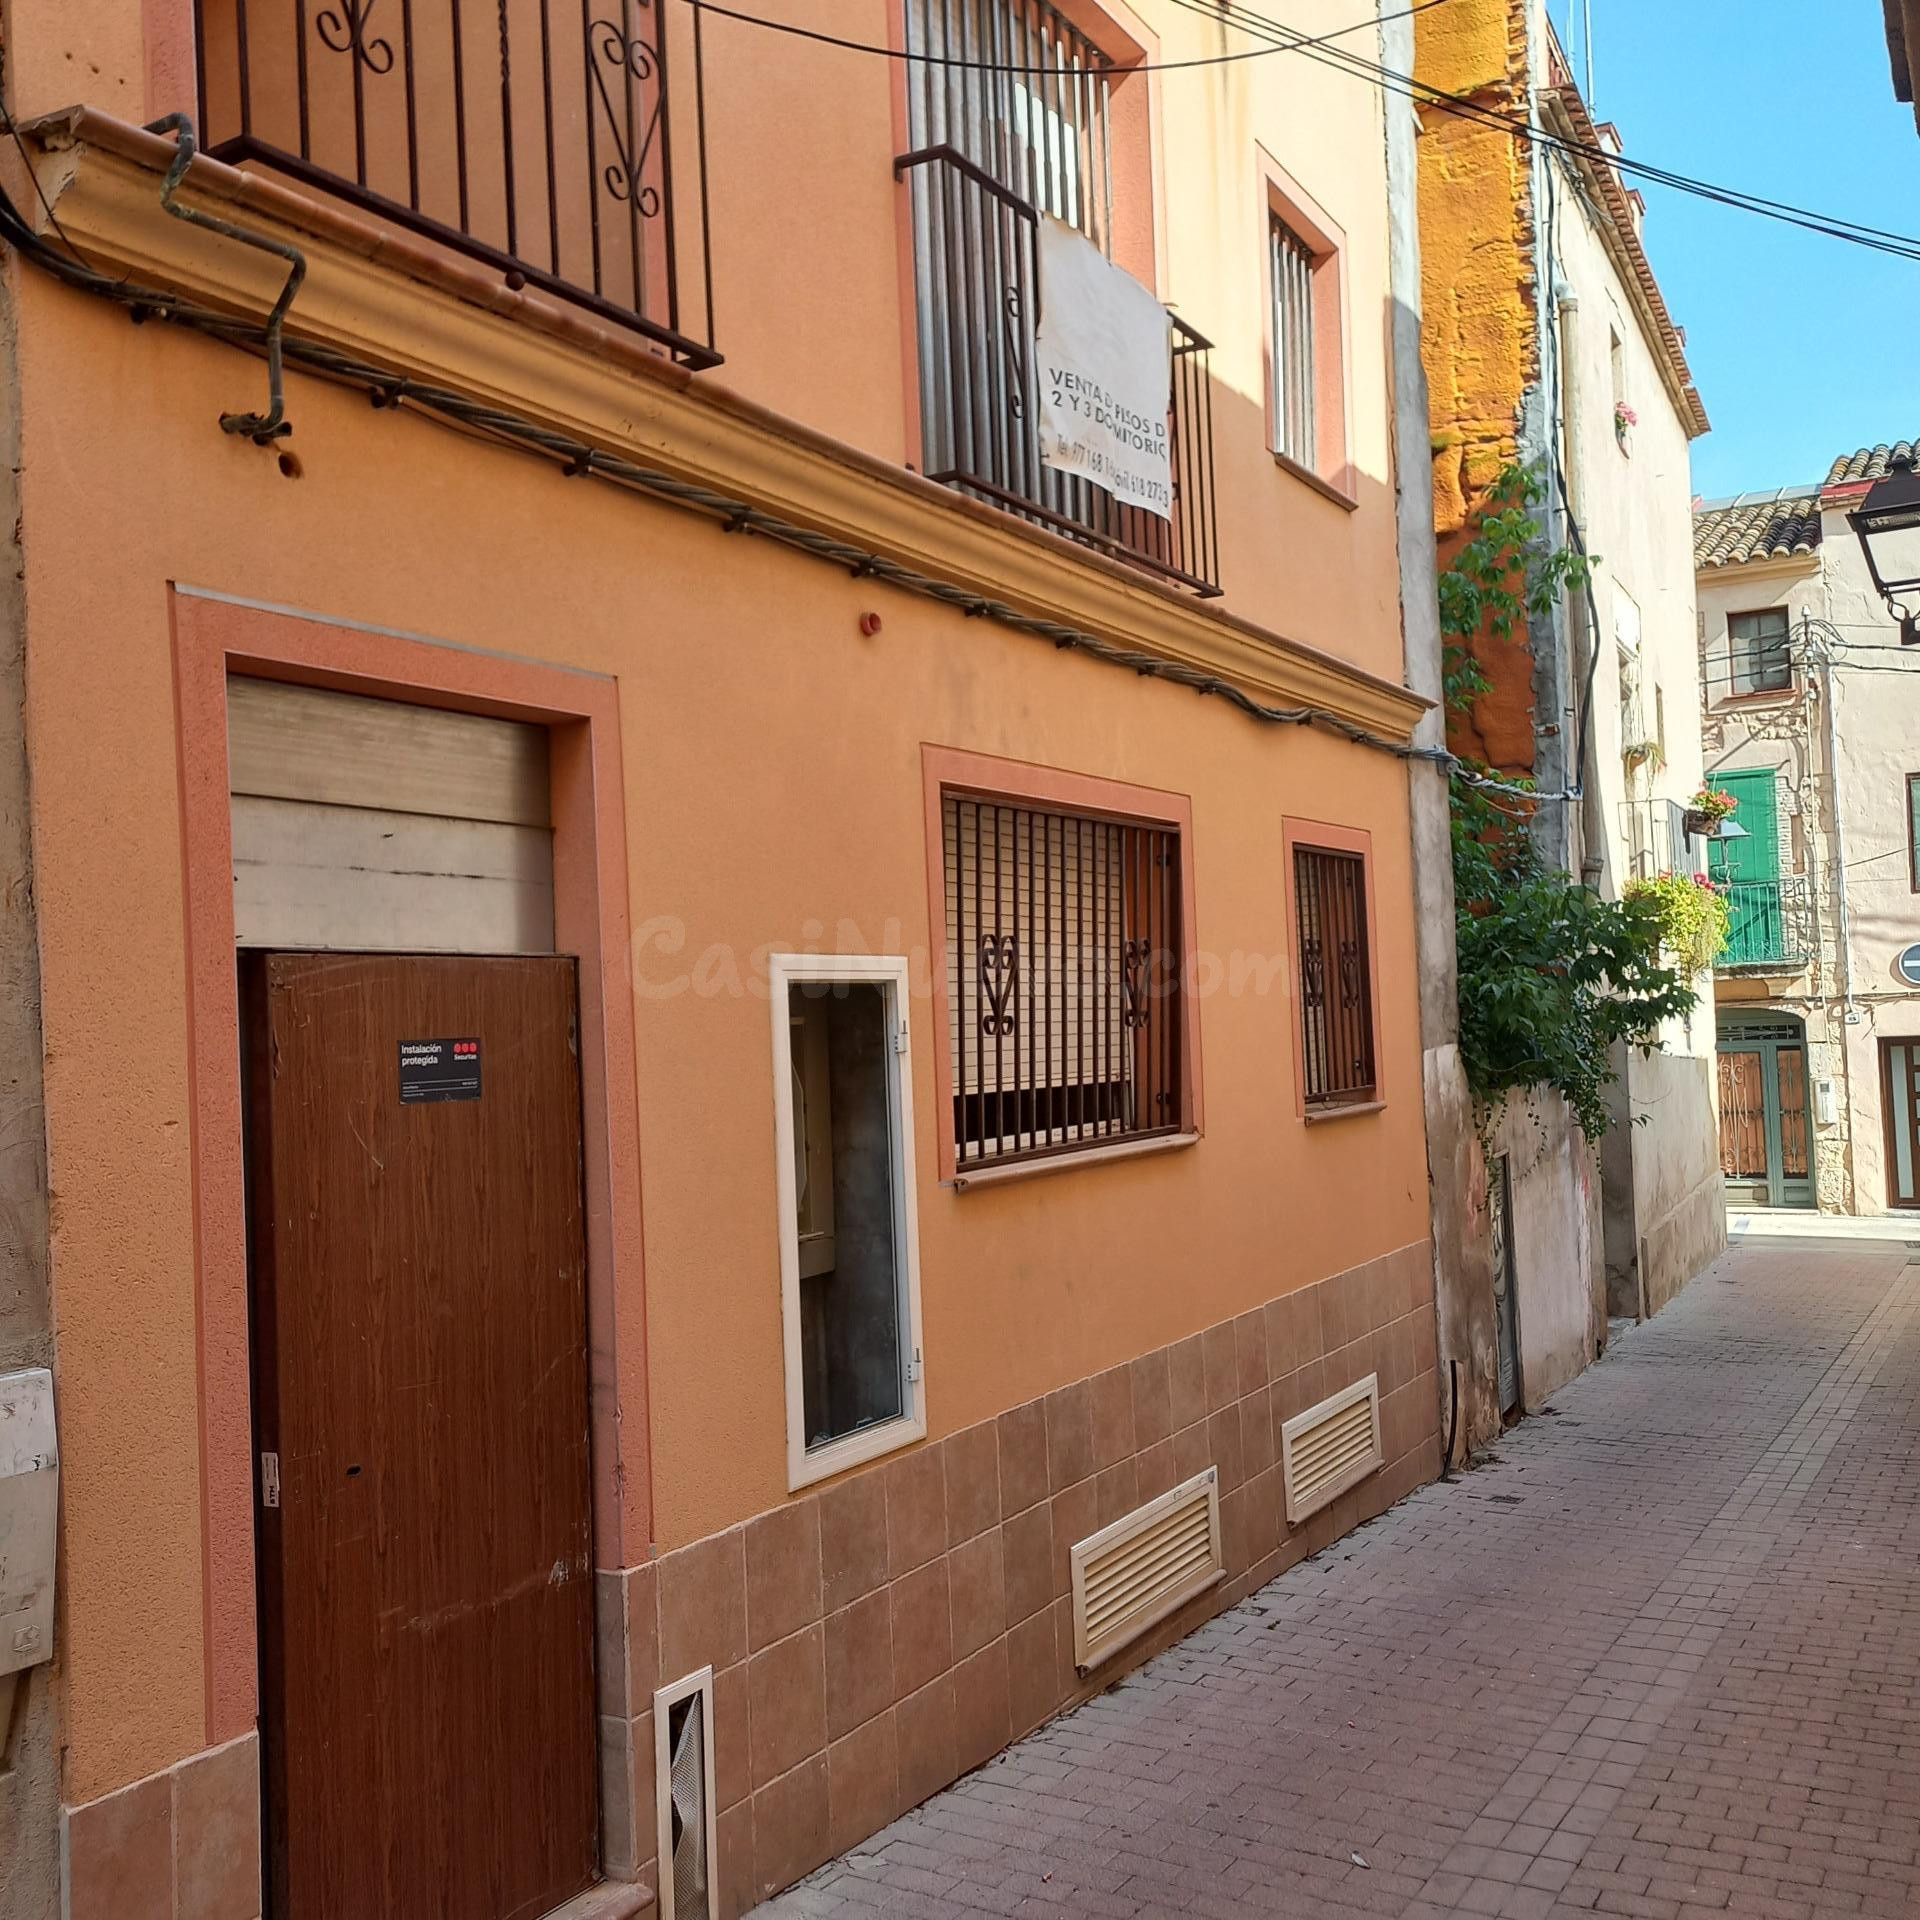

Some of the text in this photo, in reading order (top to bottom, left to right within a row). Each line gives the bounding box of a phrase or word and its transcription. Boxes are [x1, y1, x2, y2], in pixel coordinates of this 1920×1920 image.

[1049, 367, 1103, 404] VENTA
[1115, 403, 1151, 434] PISOS
[1051, 390, 1063, 408] 2
[1069, 393, 1080, 412] Y
[1083, 400, 1092, 418] 3
[401, 1044, 442, 1054] Instalación
[401, 1055, 439, 1067] protegida
